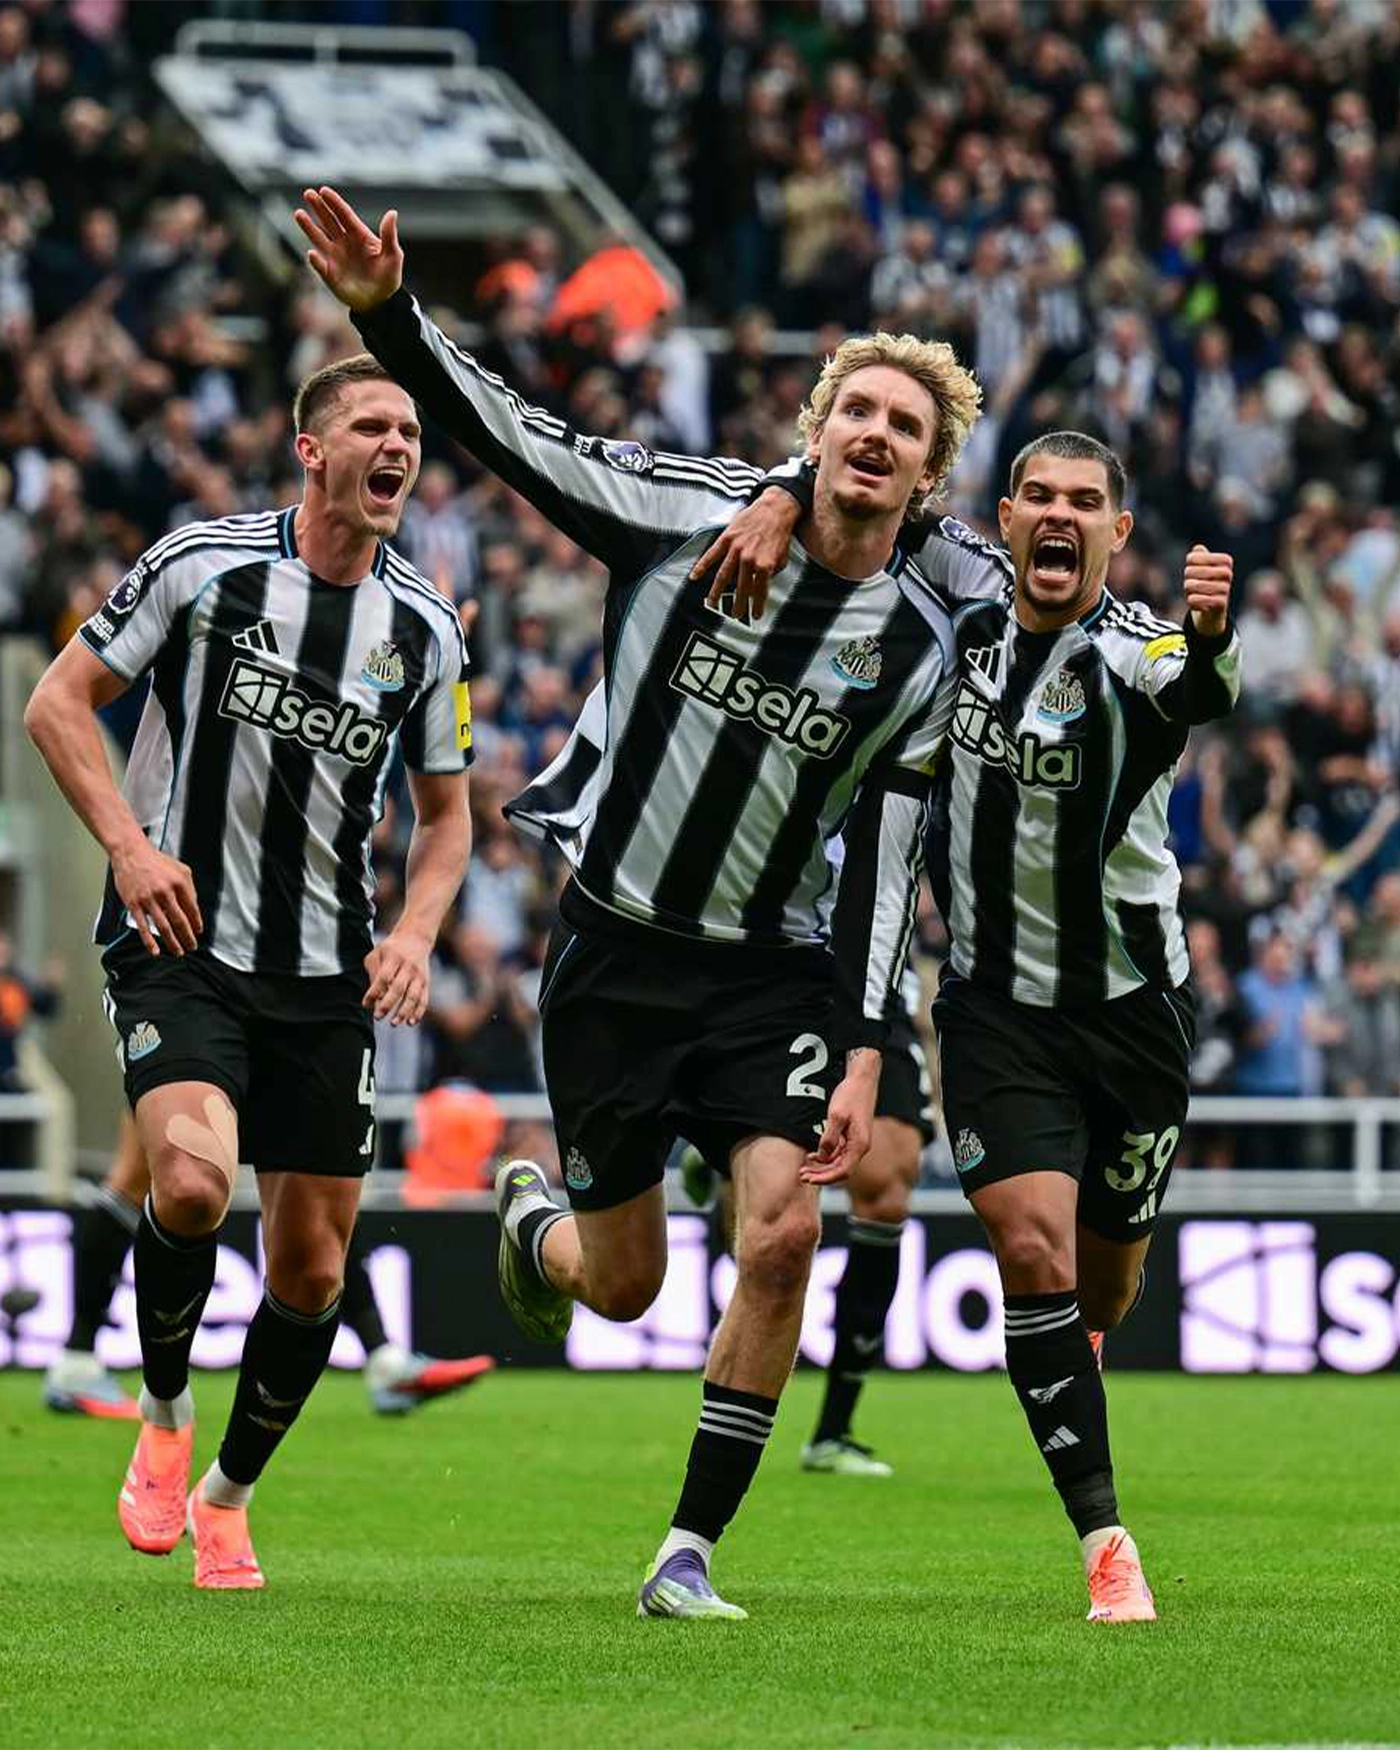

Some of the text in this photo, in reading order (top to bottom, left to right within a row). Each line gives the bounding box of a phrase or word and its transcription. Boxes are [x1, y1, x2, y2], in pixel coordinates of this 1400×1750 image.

[273, 695, 384, 760] sela
[727, 676, 843, 753] sela
[982, 721, 1074, 782] sela
[358, 1048, 376, 1116] 4
[786, 1032, 828, 1101] 2
[1104, 1125, 1180, 1192] 39
[1317, 1251, 1400, 1374] s
